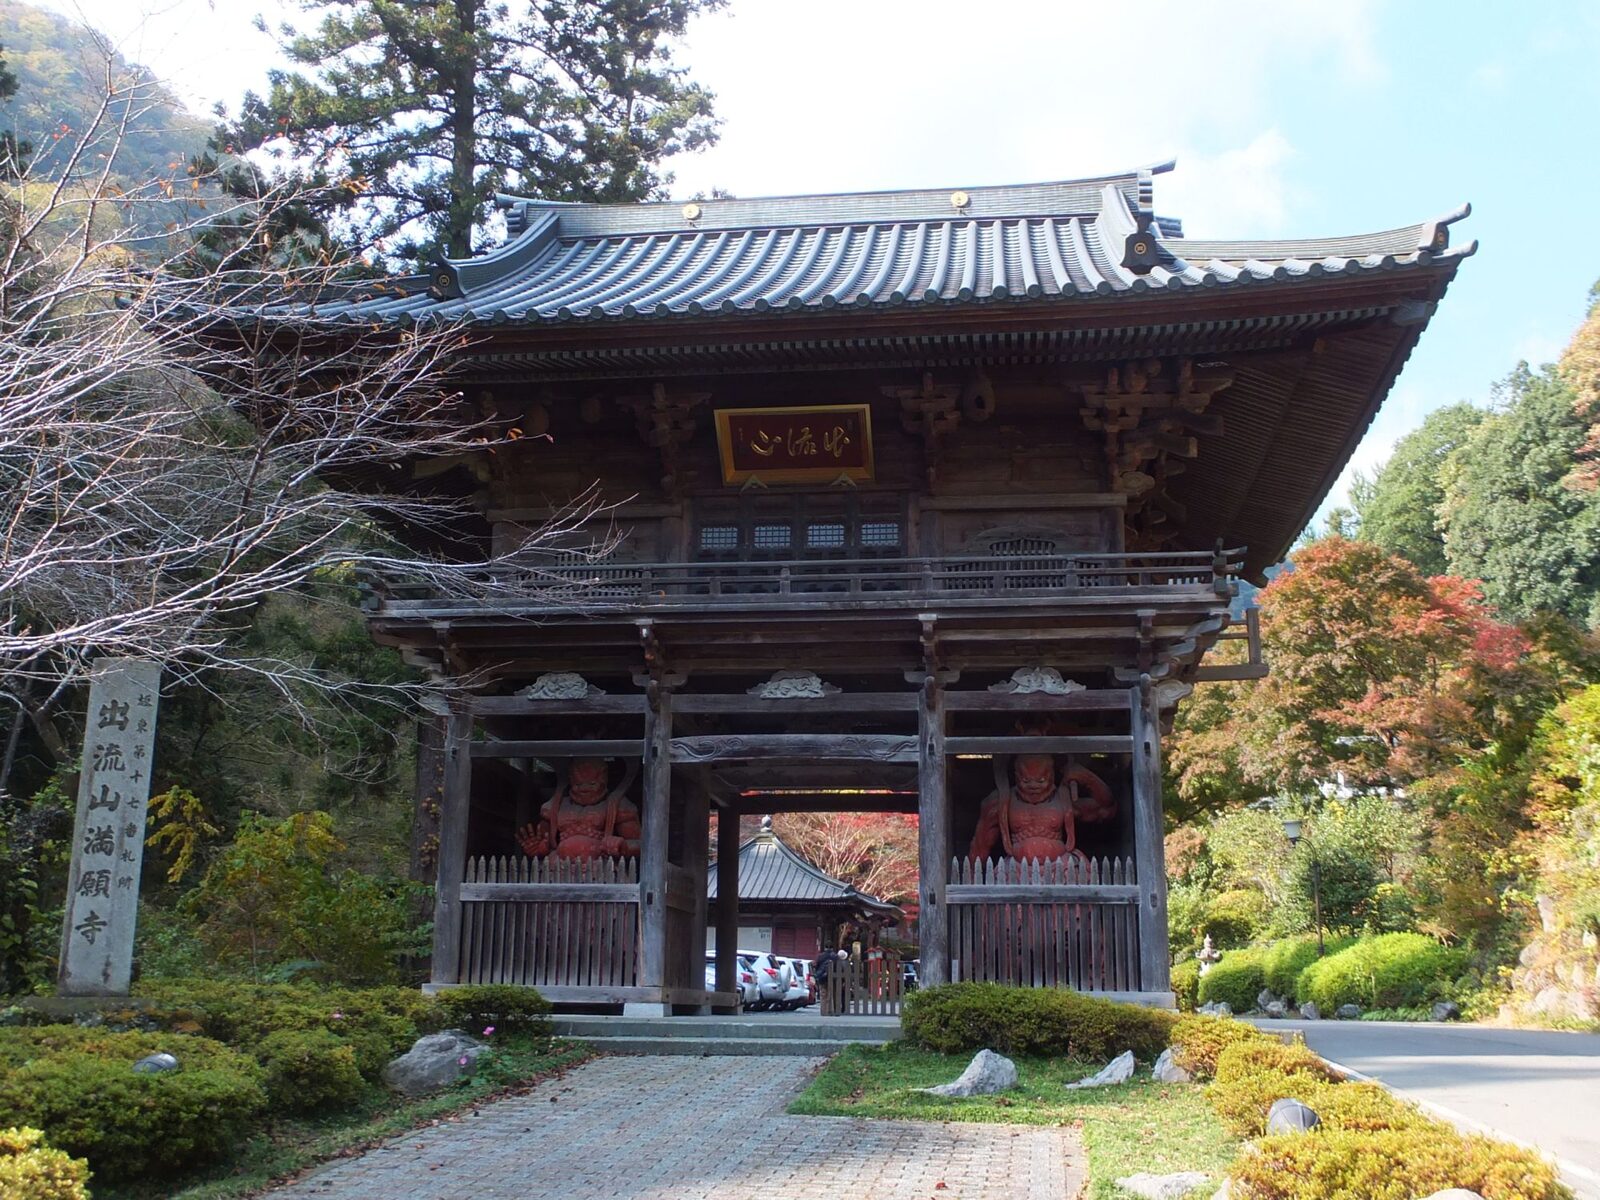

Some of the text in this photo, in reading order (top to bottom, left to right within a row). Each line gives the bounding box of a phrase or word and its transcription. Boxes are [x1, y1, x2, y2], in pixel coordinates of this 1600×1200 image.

[75, 699, 130, 945] 出流山満願寺
